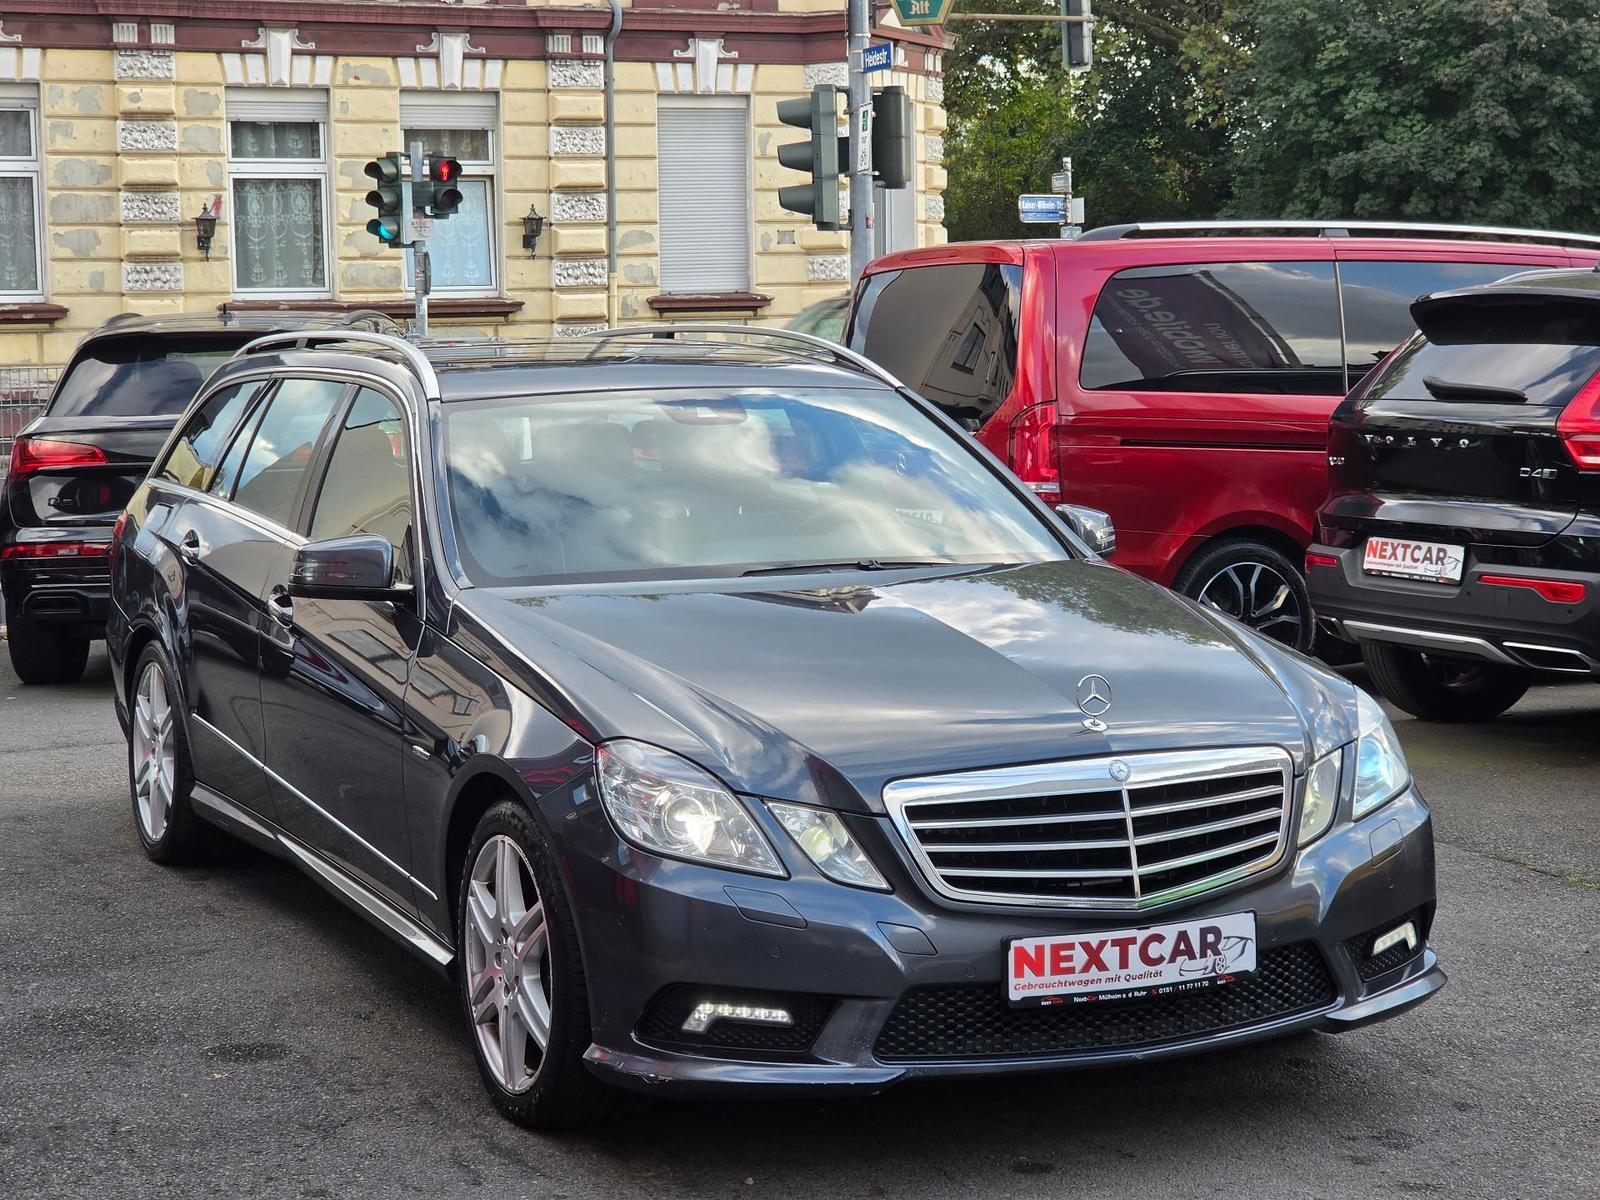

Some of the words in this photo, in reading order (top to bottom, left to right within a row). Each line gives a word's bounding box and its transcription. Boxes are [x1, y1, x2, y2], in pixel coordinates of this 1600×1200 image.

[909, 0, 930, 15] Alt
[864, 48, 890, 68] Heidestr.
[1366, 539, 1448, 566] NEXTCAR
[1013, 925, 1224, 979] NEXTCAR
[1013, 978, 1102, 991] Gebrauchtwagen
[1105, 974, 1121, 984] mit
[1124, 970, 1163, 983] Qualität
